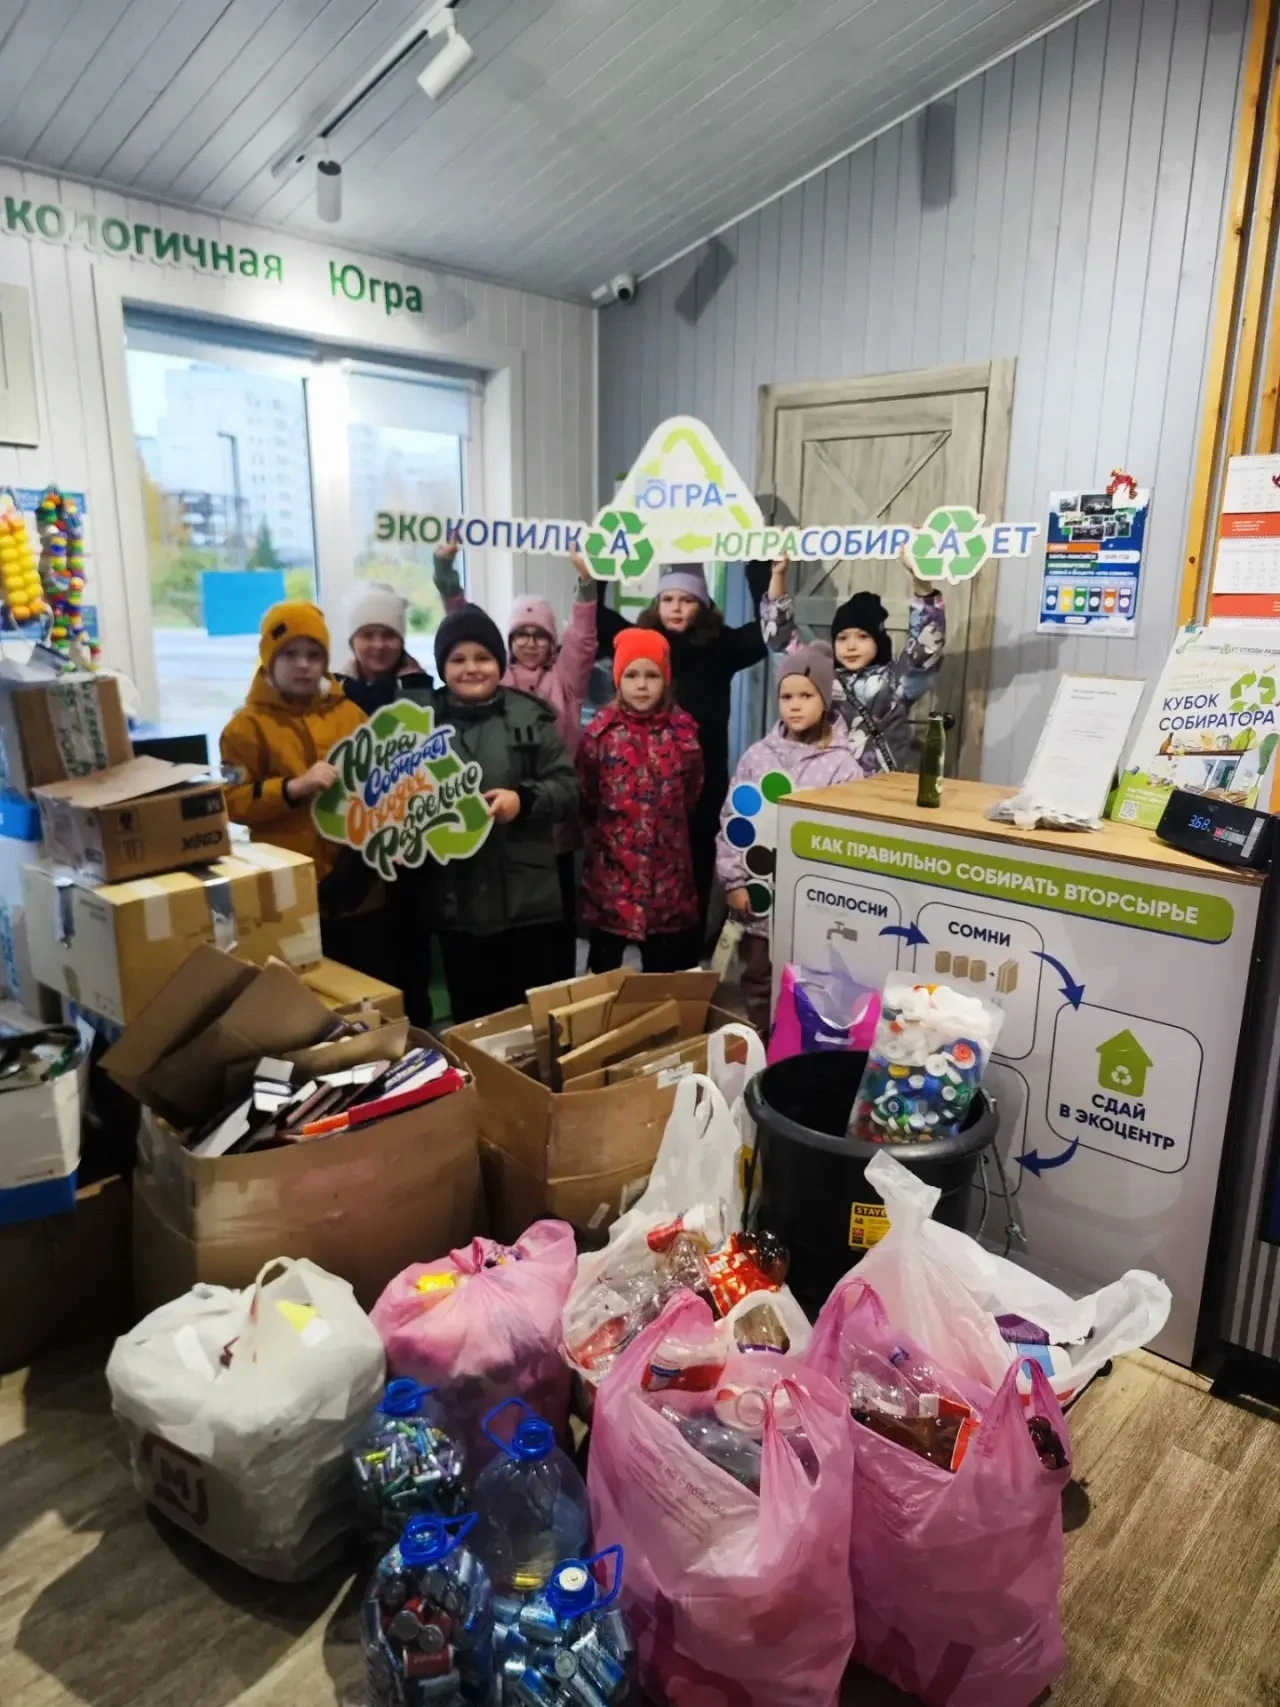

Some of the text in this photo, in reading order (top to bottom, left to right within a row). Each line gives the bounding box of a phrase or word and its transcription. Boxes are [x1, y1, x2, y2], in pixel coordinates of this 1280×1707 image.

[329, 261, 423, 315] Югра
[1163, 692, 1220, 712] КУБОК
[1158, 709, 1275, 731] СОБИРАТОРА
[328, 727, 417, 791] Югра
[811, 834, 1200, 925] КАК ПРАВИЛЬНО СОБИРАТЬ ВТОРСЫРЬЕ
[806, 888, 889, 918] СПОЛОСНИ
[948, 921, 1011, 947] СОМНИ
[1091, 1093, 1146, 1122] СДАЙ
[1059, 1103, 1175, 1150] В ЭКОЦЕНТР
